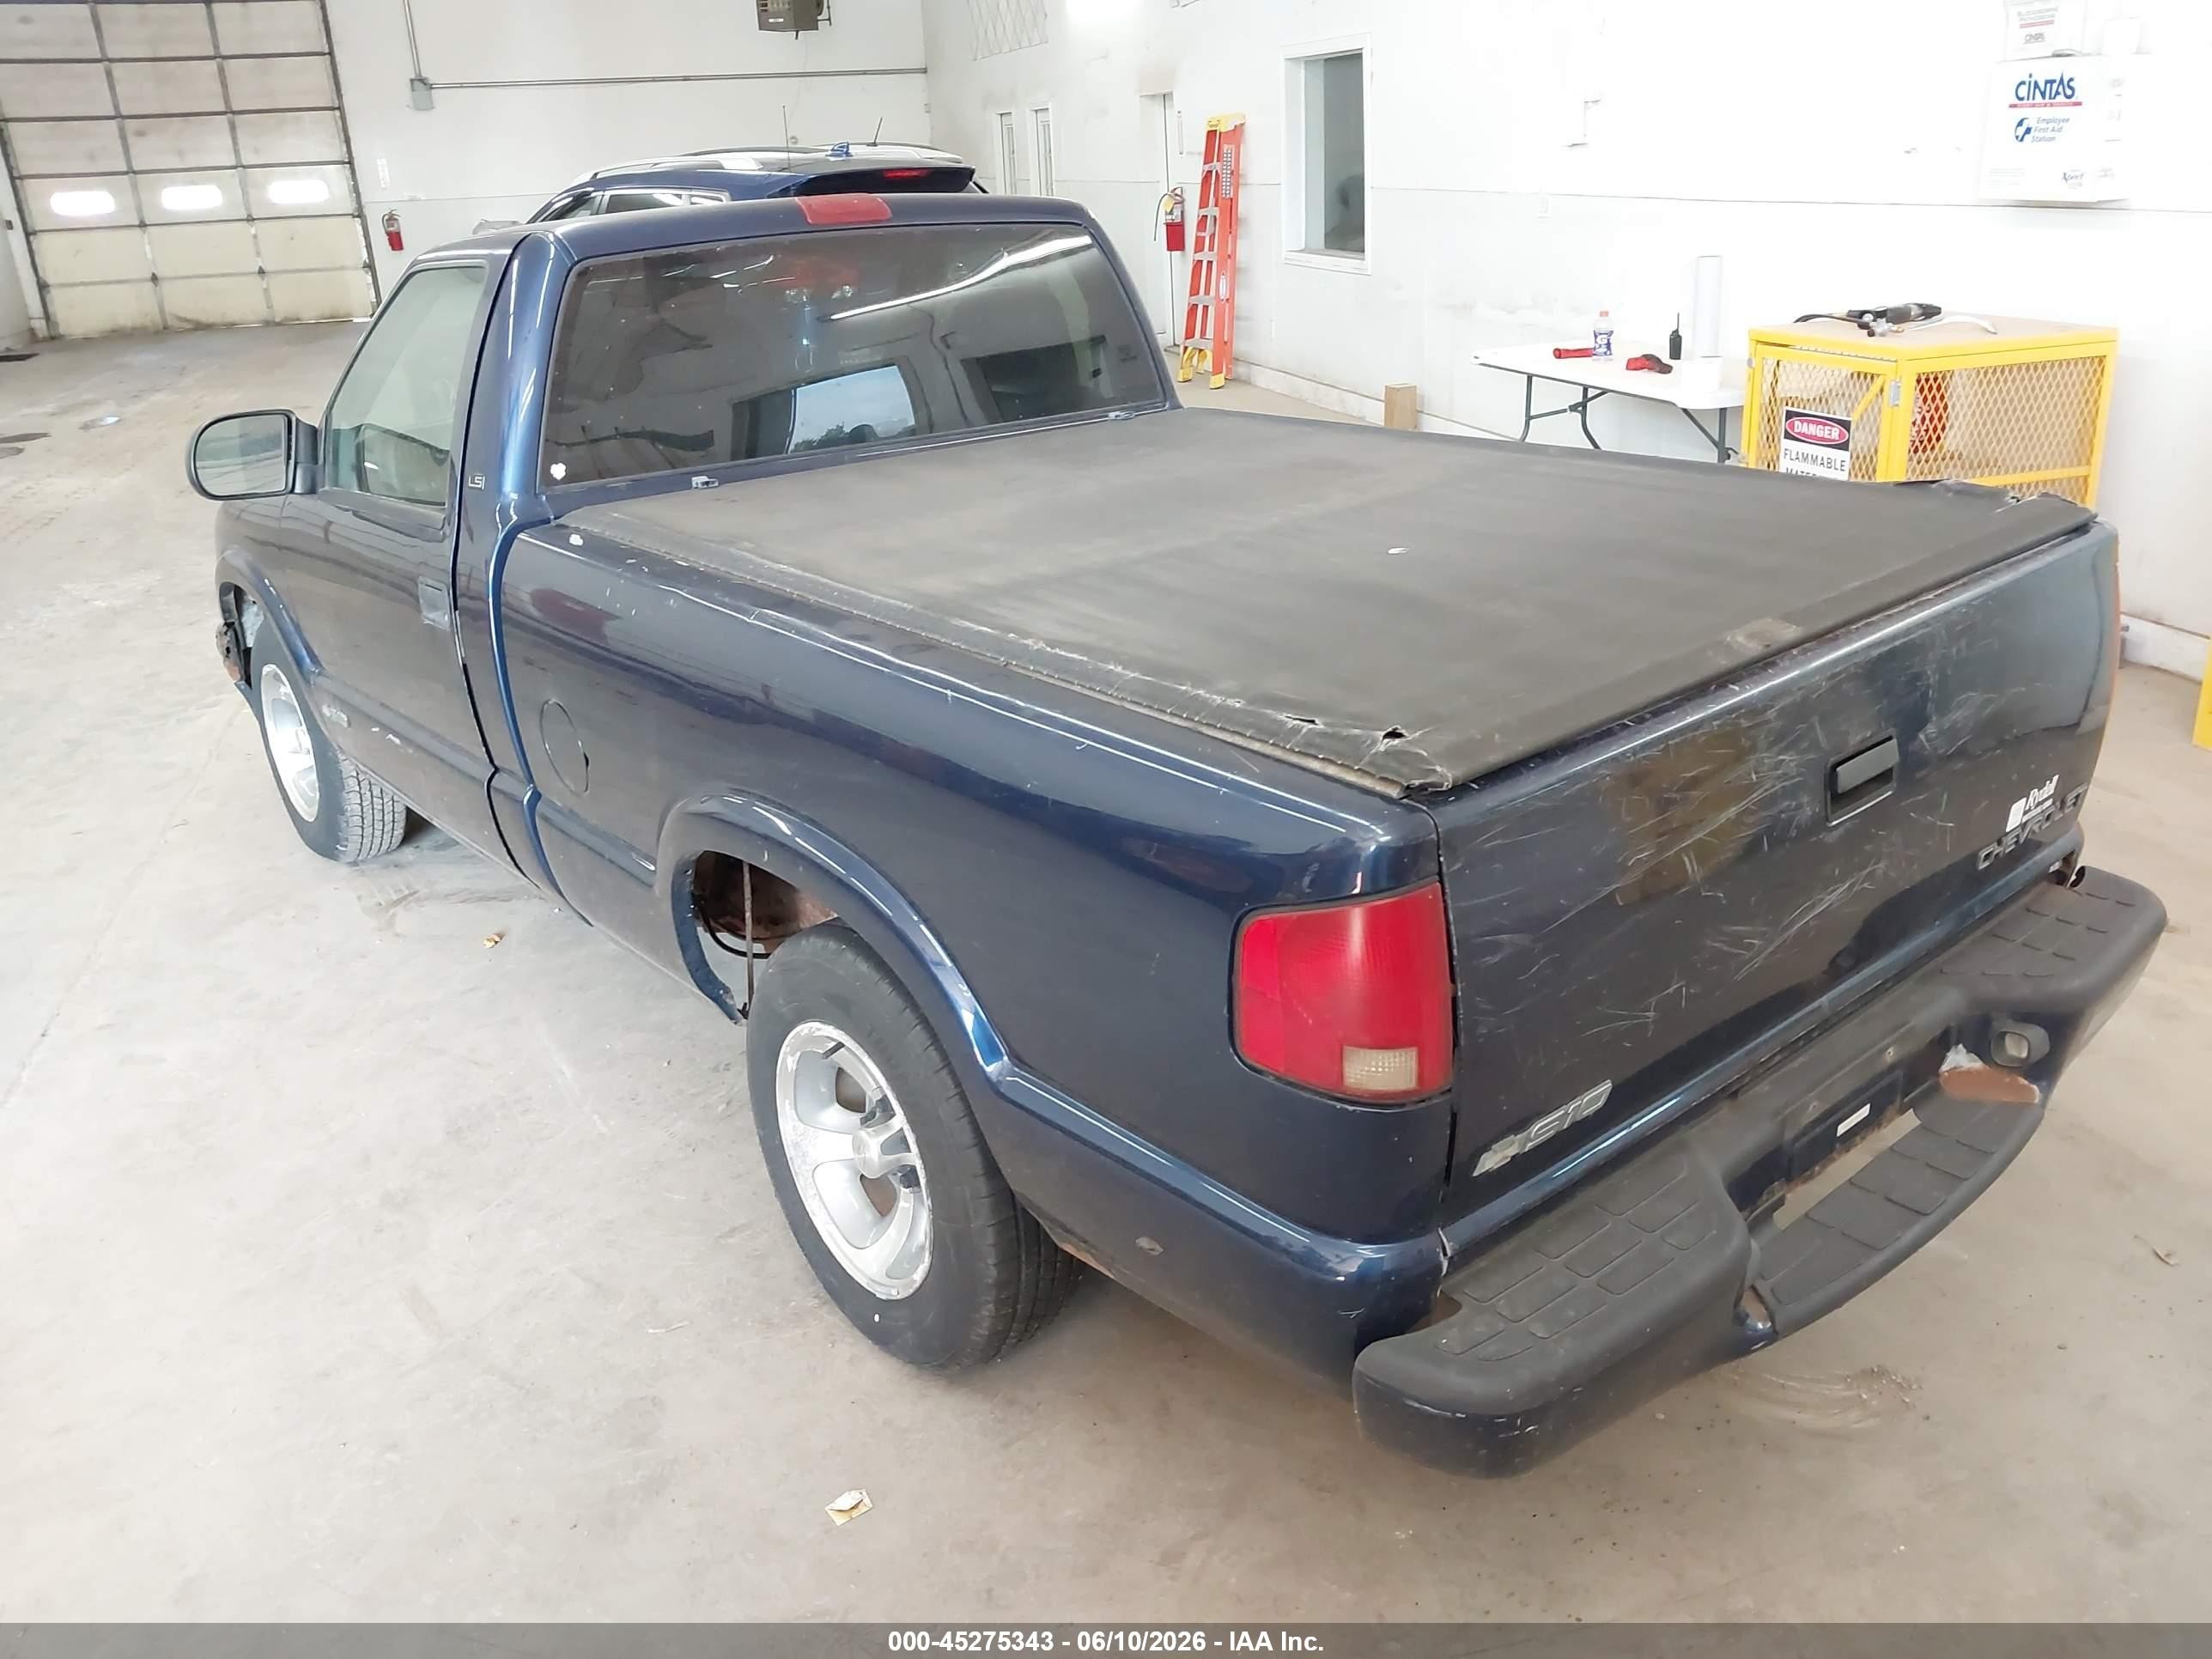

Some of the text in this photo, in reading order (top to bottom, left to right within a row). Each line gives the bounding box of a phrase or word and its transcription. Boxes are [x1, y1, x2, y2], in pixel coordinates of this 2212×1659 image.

[2036, 116, 2070, 125] Employee
[1793, 420, 1840, 441] DANGER
[1783, 448, 1846, 471] FLAMMABLE
[1978, 782, 2089, 871] CHEVROLET
